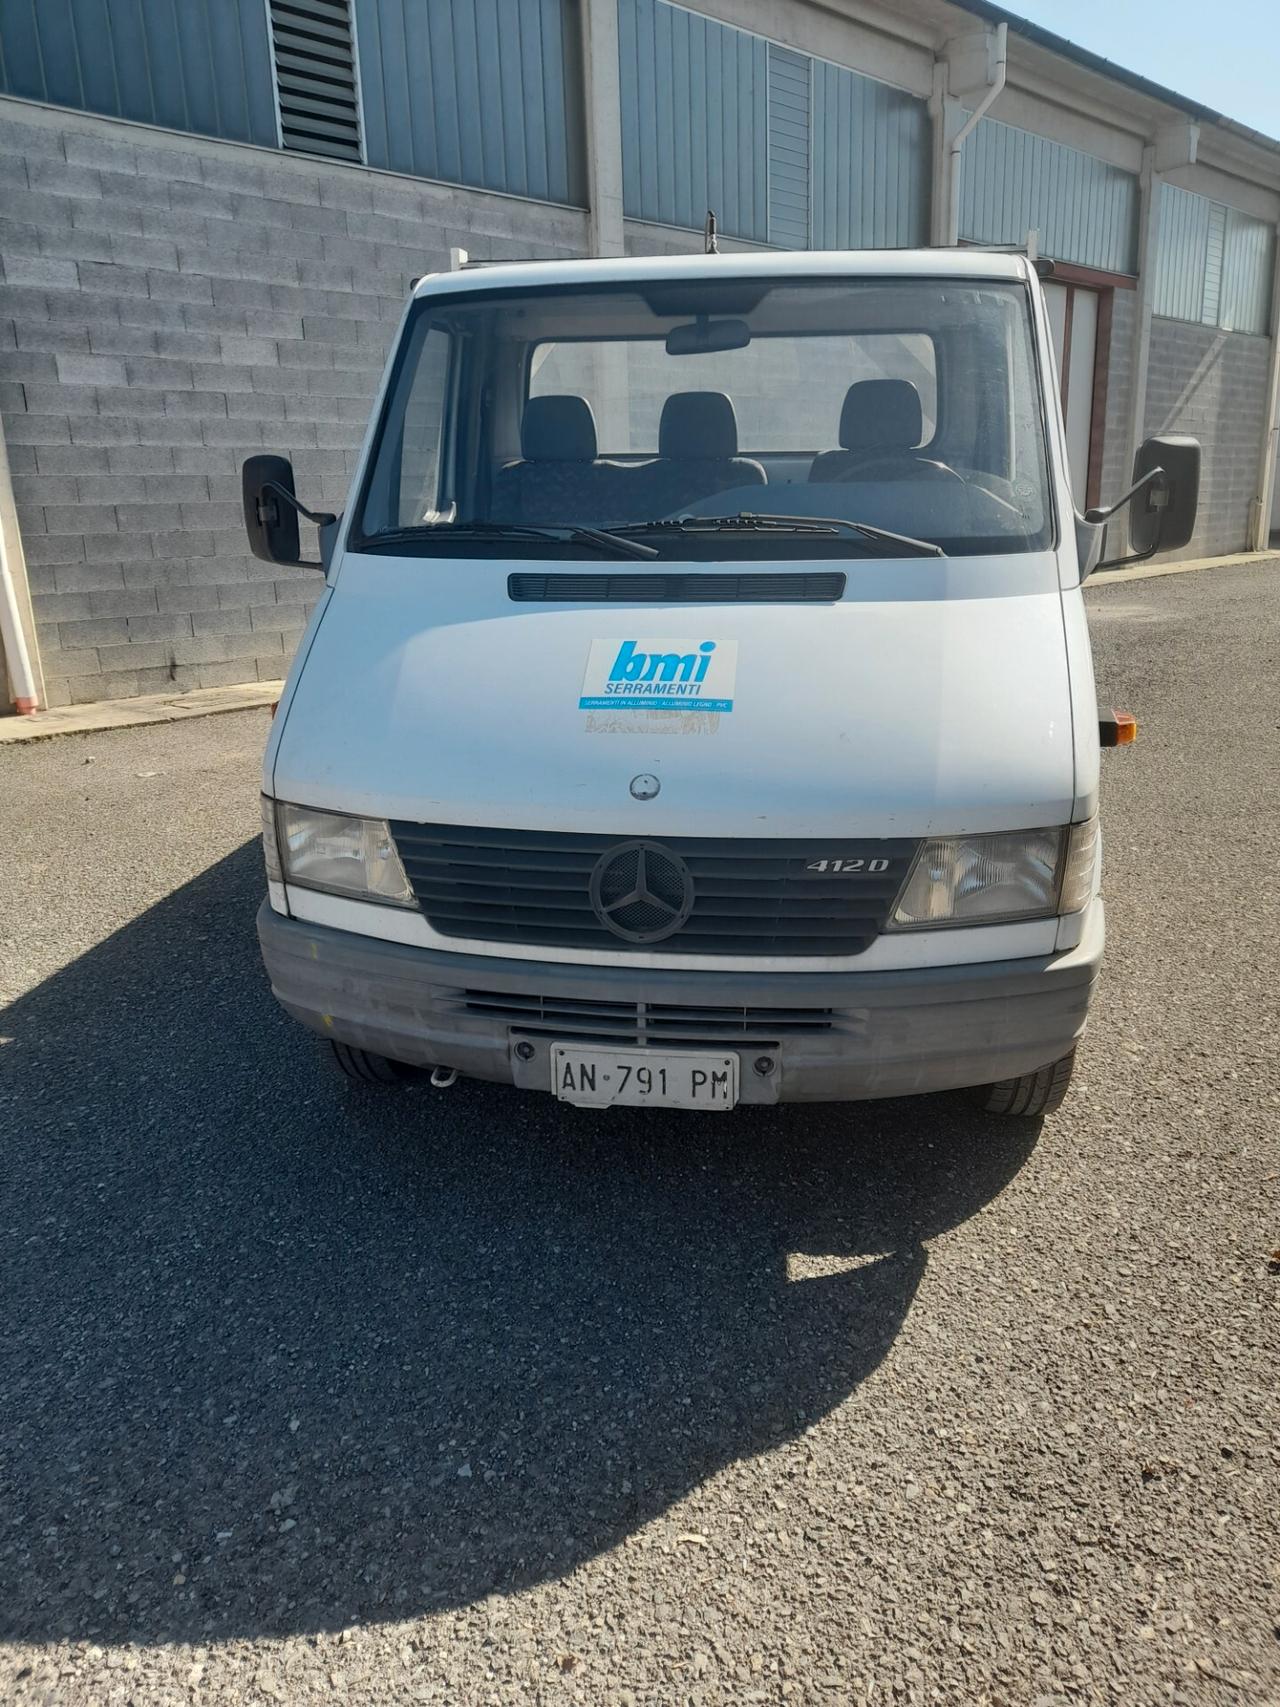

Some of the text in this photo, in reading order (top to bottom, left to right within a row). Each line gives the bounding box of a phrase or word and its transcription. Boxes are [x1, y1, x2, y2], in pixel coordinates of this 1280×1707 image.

[608, 641, 716, 682] bmi
[604, 683, 701, 695] SERRAMENTI
[562, 1062, 728, 1100] AN 791 PM
